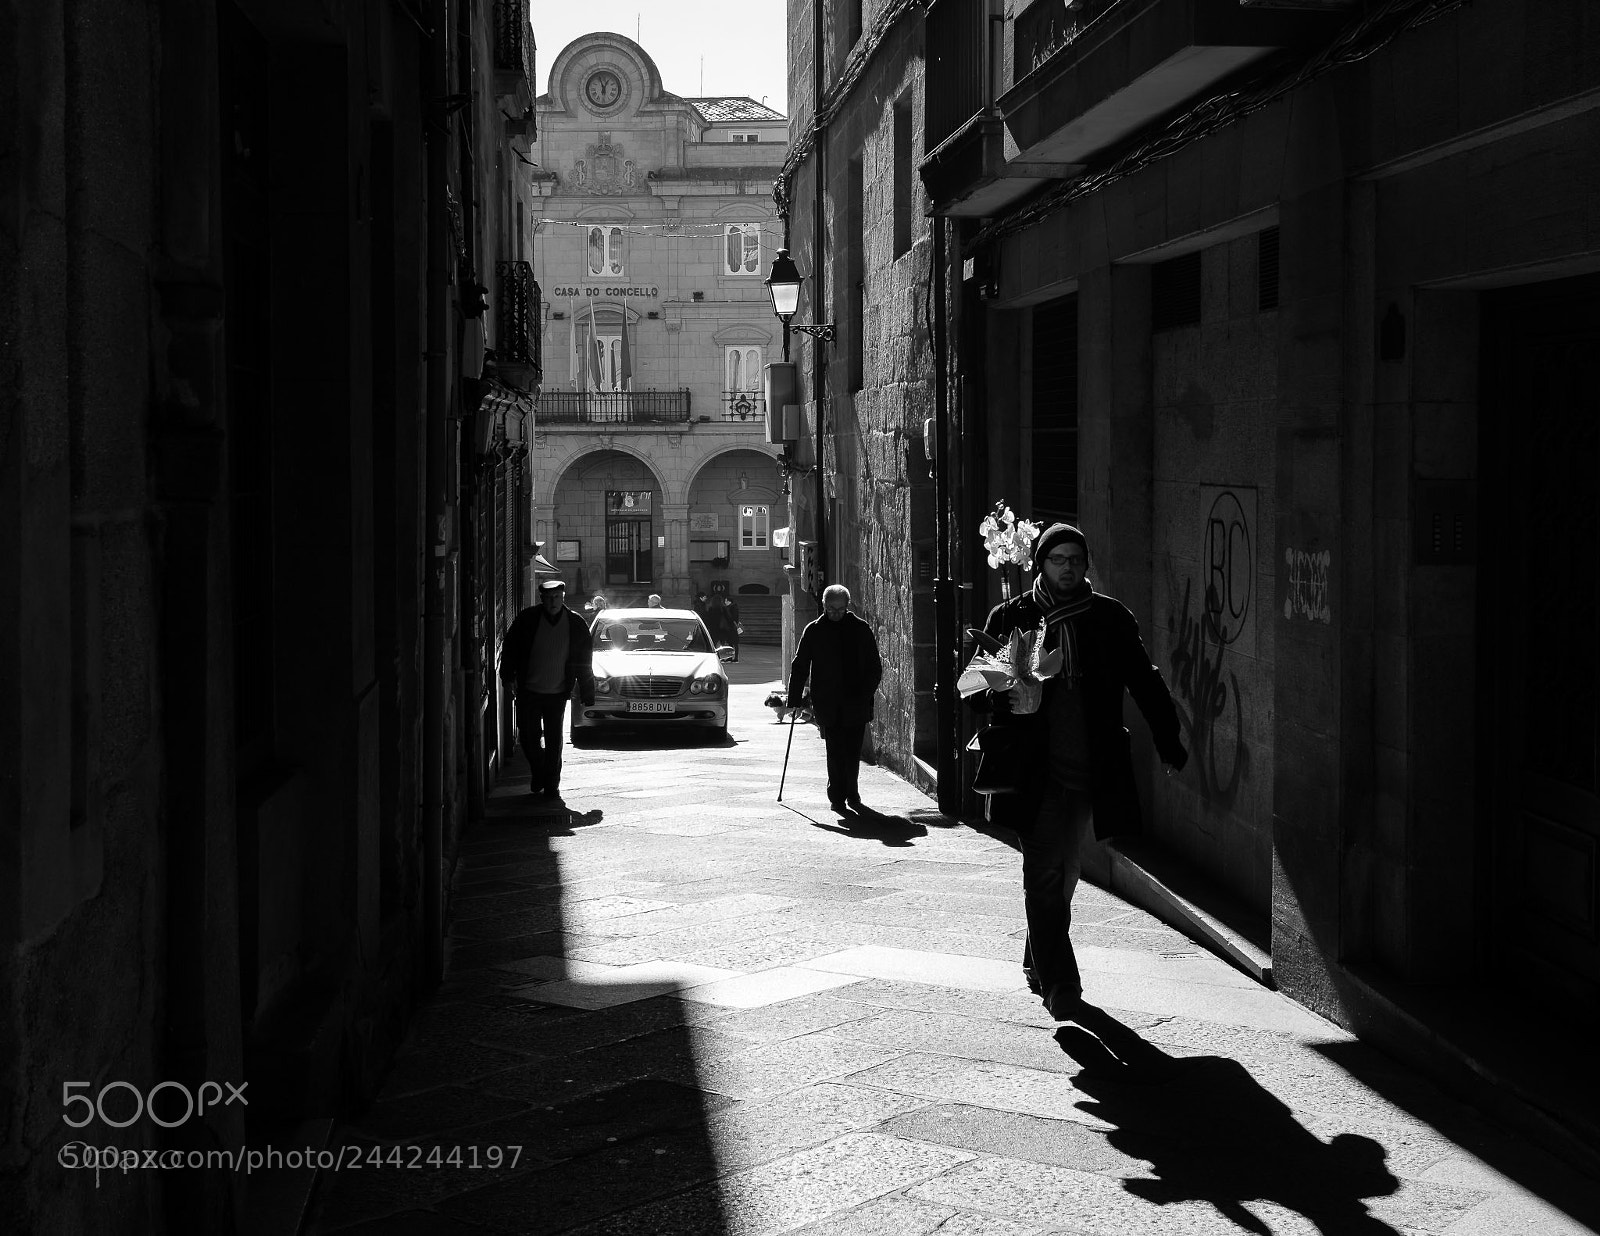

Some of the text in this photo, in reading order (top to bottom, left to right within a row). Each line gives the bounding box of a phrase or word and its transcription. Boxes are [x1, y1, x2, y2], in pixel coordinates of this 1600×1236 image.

[554, 287, 658, 297] CASA DO CONCELLO
[1210, 518, 1245, 619] BC
[632, 702, 673, 712] 8858 DVL
